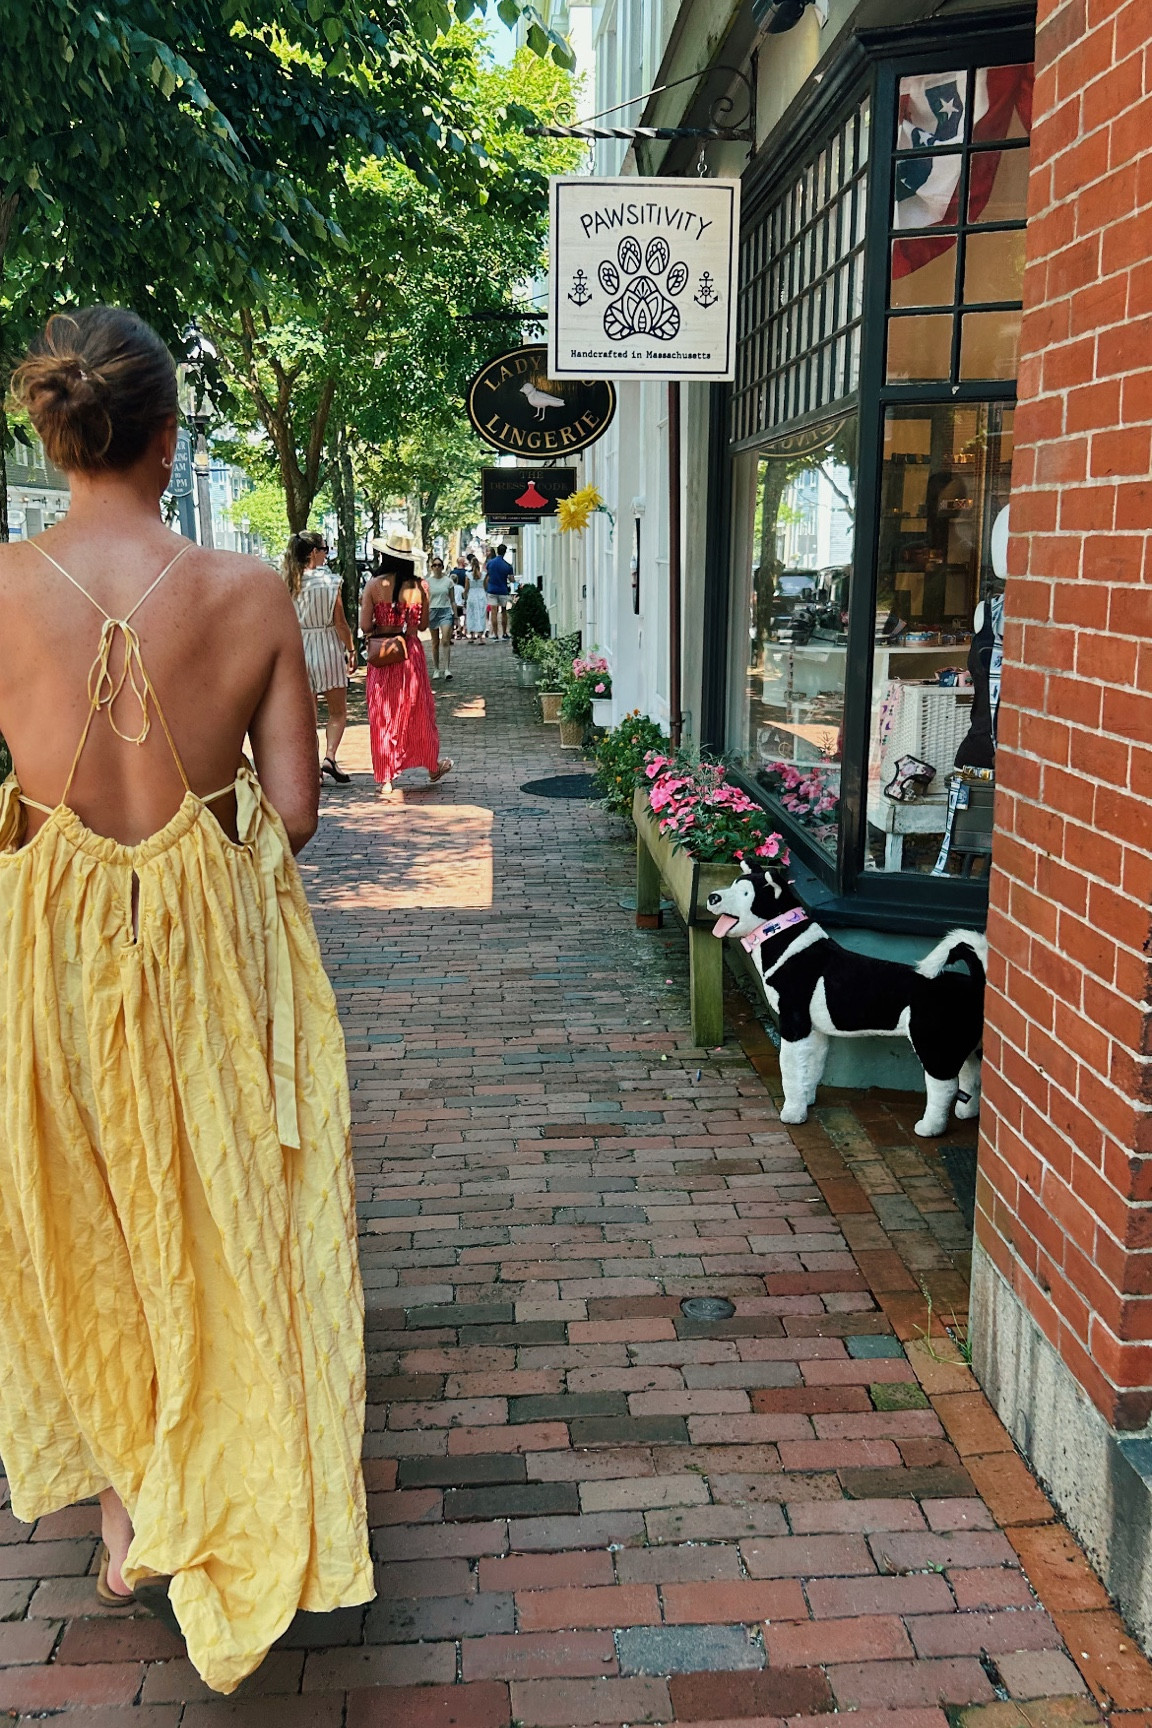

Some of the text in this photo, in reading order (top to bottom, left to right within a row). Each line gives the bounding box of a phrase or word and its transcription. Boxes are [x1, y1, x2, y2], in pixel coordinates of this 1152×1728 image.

[580, 203, 713, 240] PAWSITIVITY
[570, 349, 711, 360] Handcrafted in Massachusetts
[484, 356, 542, 392] LADY
[485, 409, 600, 449] LINGERIE
[519, 470, 545, 479] THE
